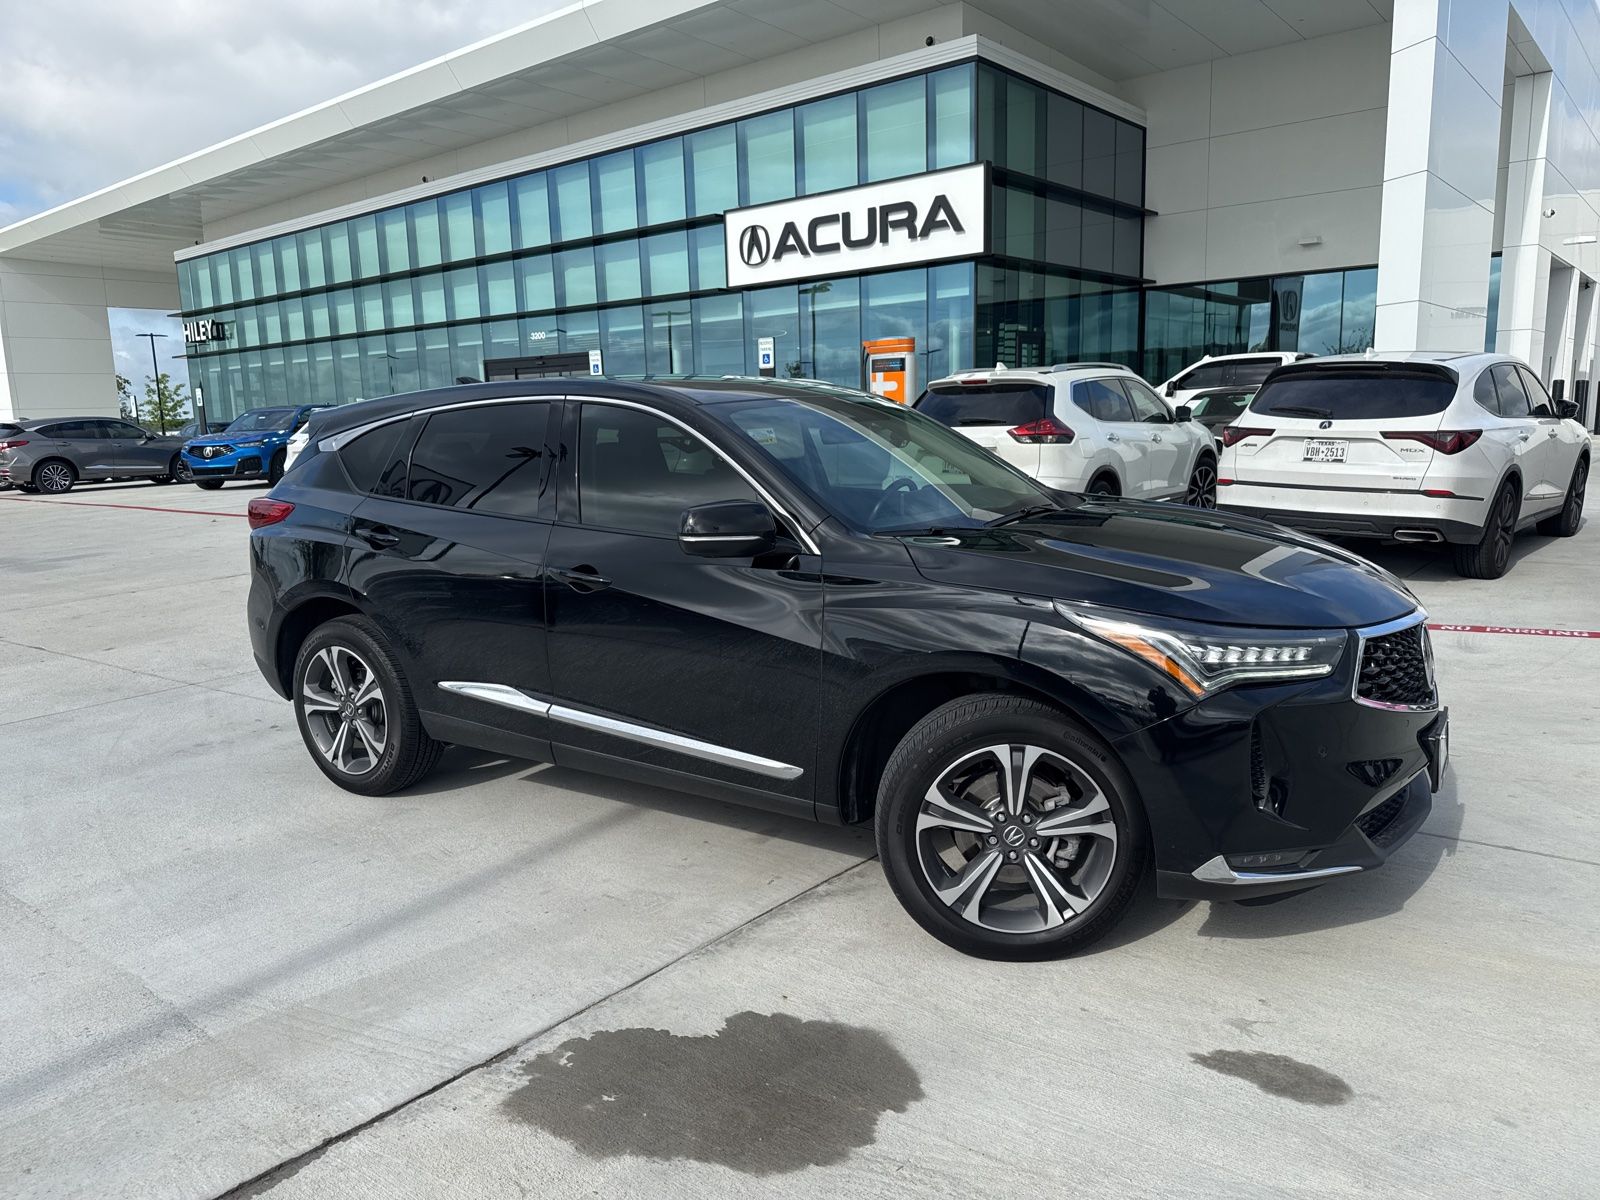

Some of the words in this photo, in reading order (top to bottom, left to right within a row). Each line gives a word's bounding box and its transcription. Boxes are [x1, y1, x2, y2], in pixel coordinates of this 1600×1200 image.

[772, 194, 965, 260] ACURA
[182, 319, 212, 342] HILEY
[530, 331, 546, 340] 3200
[1486, 626, 1589, 637] PARKING
